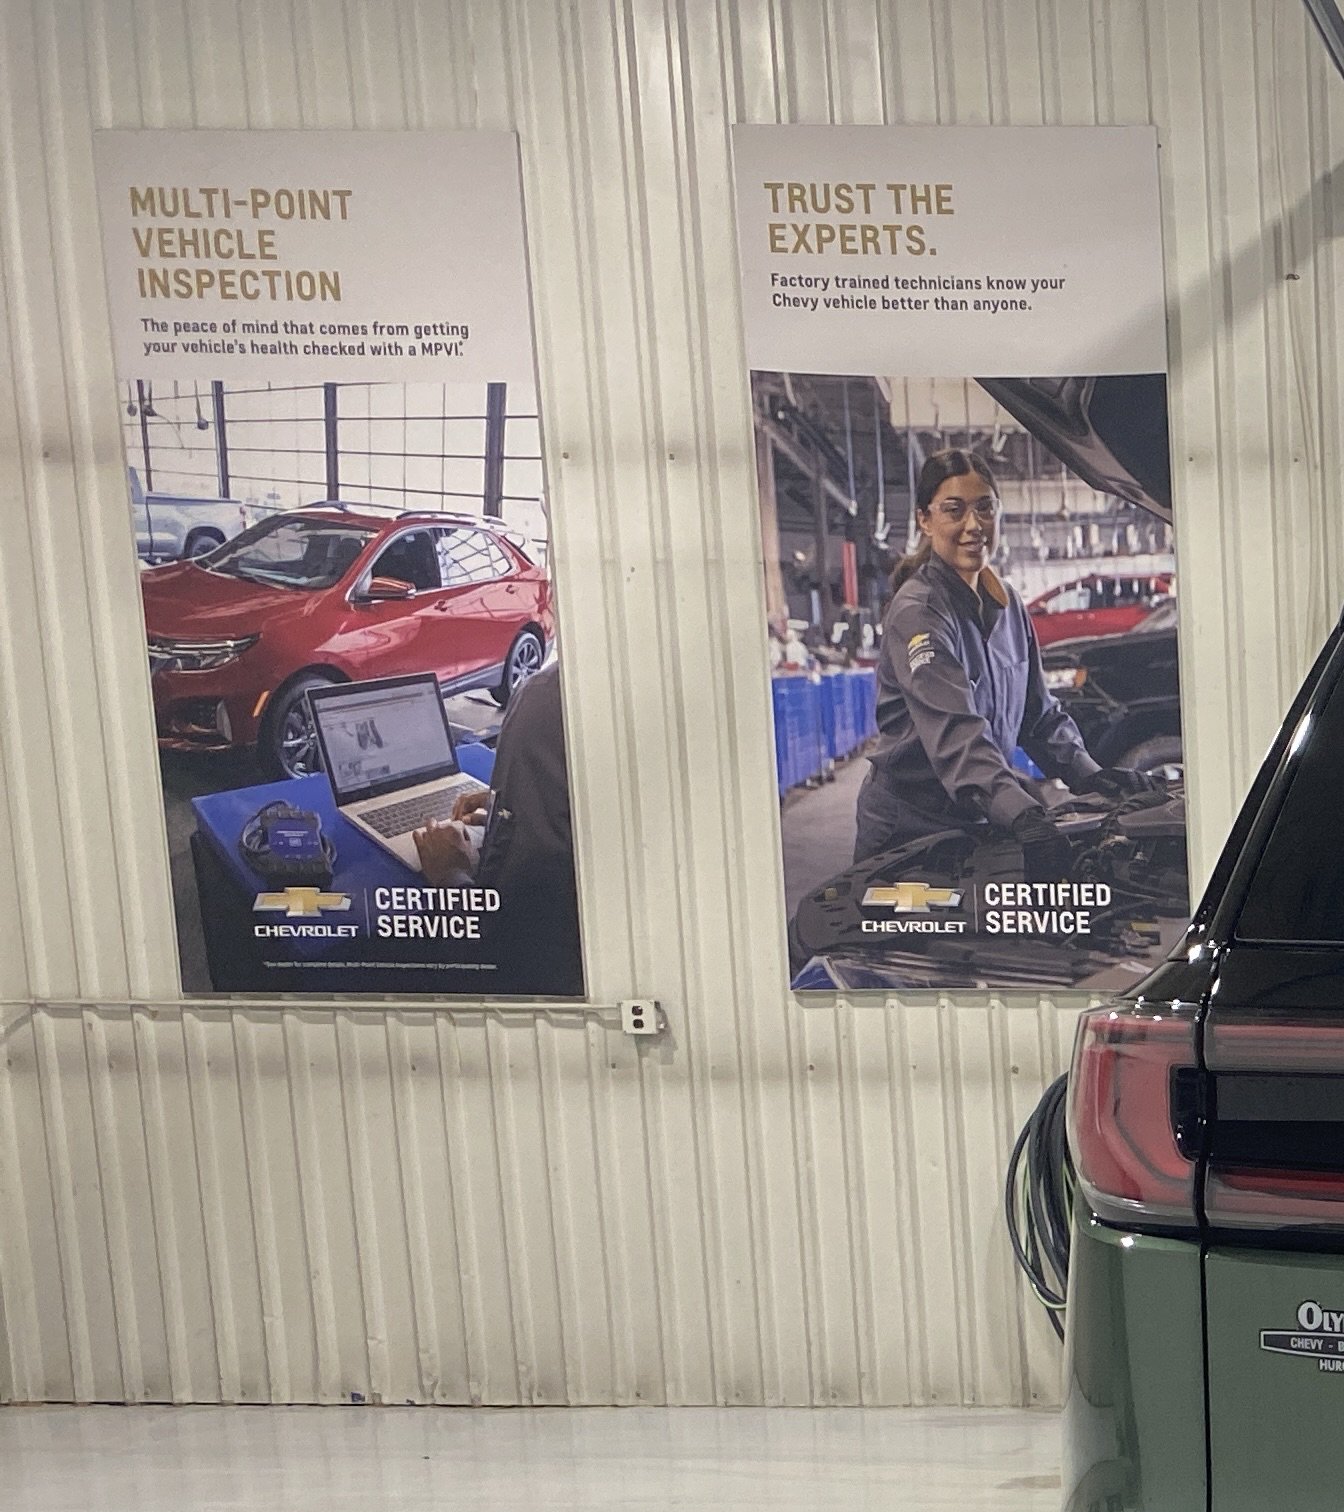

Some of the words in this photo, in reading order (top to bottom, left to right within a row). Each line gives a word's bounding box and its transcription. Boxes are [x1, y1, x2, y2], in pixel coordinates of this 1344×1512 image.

[129, 186, 353, 221] MULTI-POINT
[764, 182, 876, 215] TRUST
[886, 184, 955, 215] THE
[131, 227, 278, 260] VEHICLE
[768, 223, 937, 256] EXPERTS.
[137, 268, 342, 301] INSPECTION
[771, 273, 829, 292] Factory
[834, 274, 890, 290] trained
[894, 275, 982, 291] technicians
[986, 276, 1026, 291] know
[1030, 277, 1066, 293] your
[772, 293, 819, 311] Chevy
[823, 294, 877, 310] vehicle
[881, 295, 930, 311] better
[934, 296, 969, 311] than
[973, 299, 1032, 314] anyone.
[141, 318, 168, 334] The
[173, 320, 217, 337] peace
[222, 320, 237, 334] of
[242, 320, 279, 335] mind
[283, 321, 315, 336] that
[319, 323, 369, 337] comes
[372, 321, 409, 337] from
[413, 321, 469, 340] getting
[143, 342, 177, 356] your
[182, 340, 246, 356] vehicle's
[250, 340, 299, 356] health
[302, 340, 365, 357] checked
[370, 340, 403, 357] with
[408, 345, 417, 357] a
[374, 887, 501, 913] CERTIFIED
[984, 882, 1111, 907] CERTIFIED
[254, 924, 359, 938] CHEVROLET
[376, 915, 481, 939] SERVICE
[861, 920, 967, 934] CHEVROLET
[985, 910, 1091, 934] SERVICE
[1290, 1337, 1324, 1350] CHEVY
